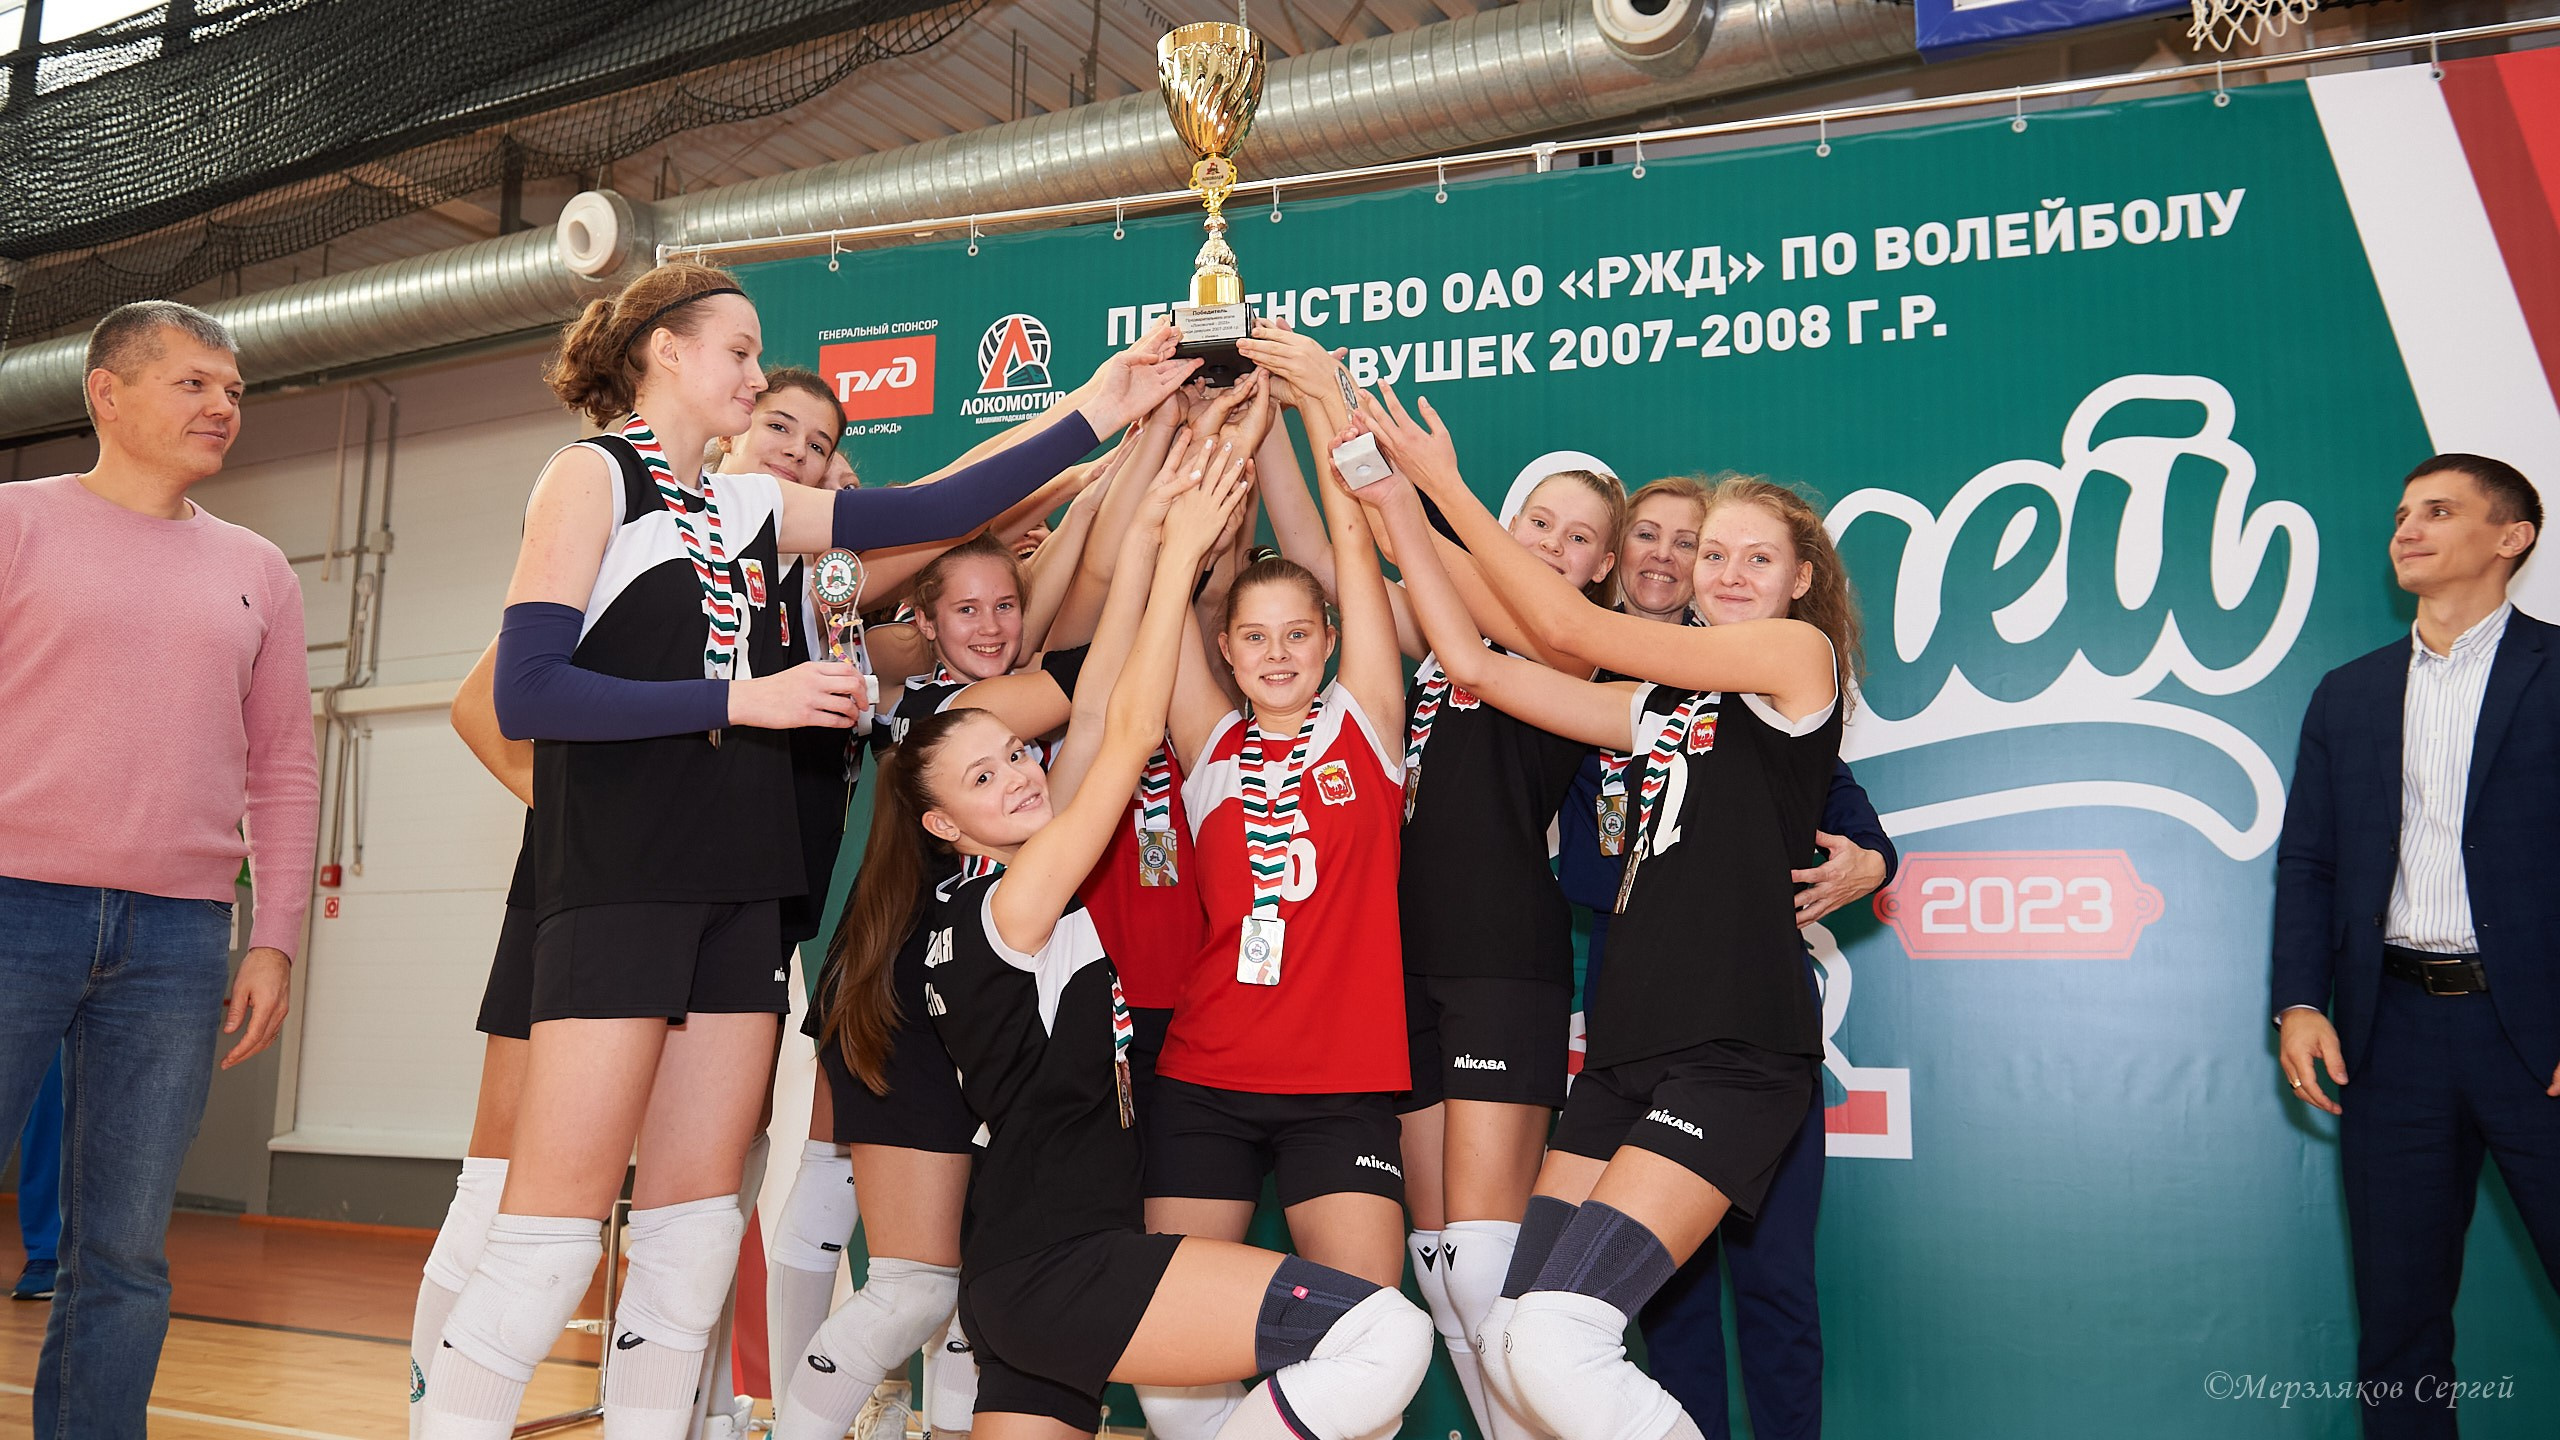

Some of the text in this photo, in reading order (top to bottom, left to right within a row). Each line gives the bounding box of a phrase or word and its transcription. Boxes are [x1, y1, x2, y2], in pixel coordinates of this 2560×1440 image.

[1107, 188, 2246, 347] ПЕНСТВО ОАО «РЖД» ПО ВОЛЕЙБОЛУ
[818, 319, 939, 341] ГЕНЕРАЛЬНЫЙ СПОНСОР
[1328, 294, 1948, 388] ВУШЕК 2007-2008 Г.Р.
[845, 422, 902, 437] ОАО «РЖД»
[1920, 876, 2114, 934] 2023
